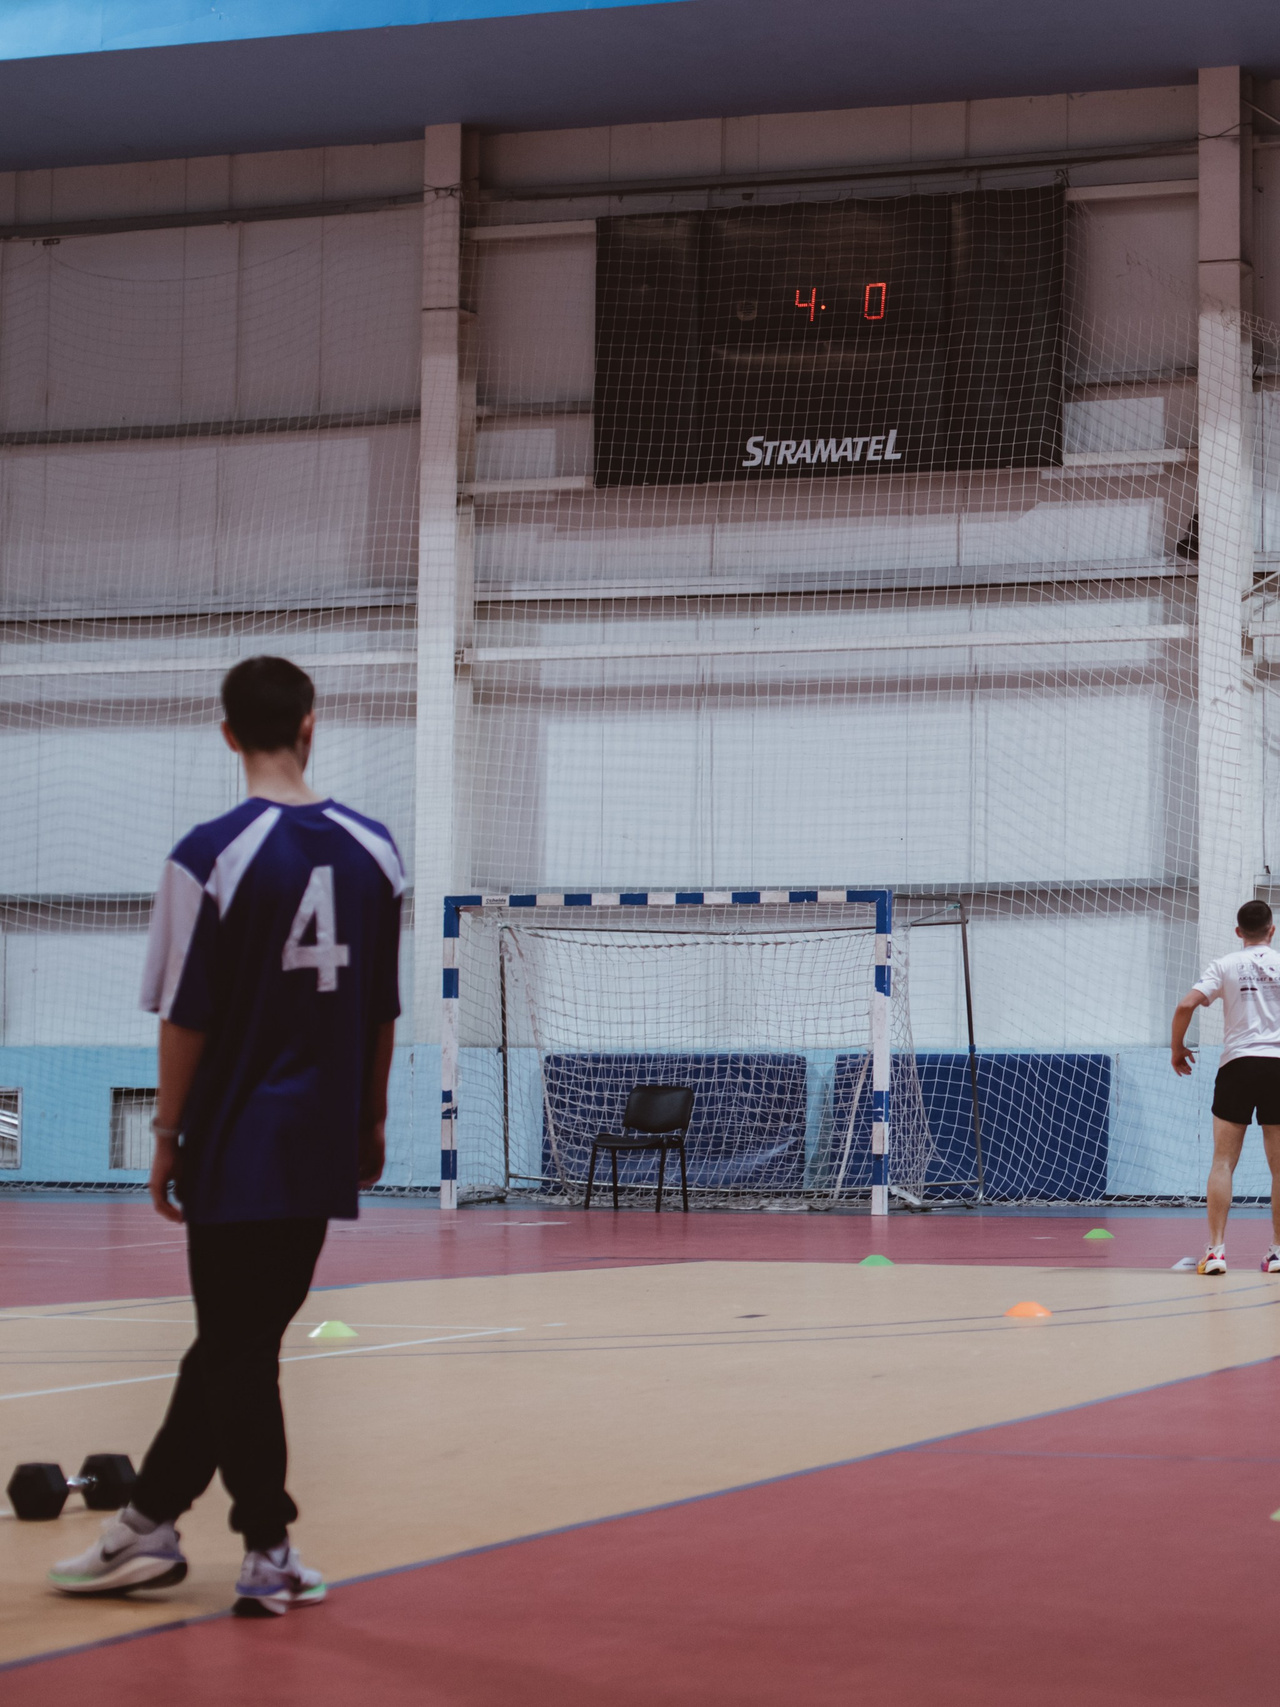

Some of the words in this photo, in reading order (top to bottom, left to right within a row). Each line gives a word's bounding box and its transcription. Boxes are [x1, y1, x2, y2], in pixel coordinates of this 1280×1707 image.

[864, 282, 886, 319] 0
[742, 429, 902, 467] STRAMATEL
[282, 865, 349, 992] 4
